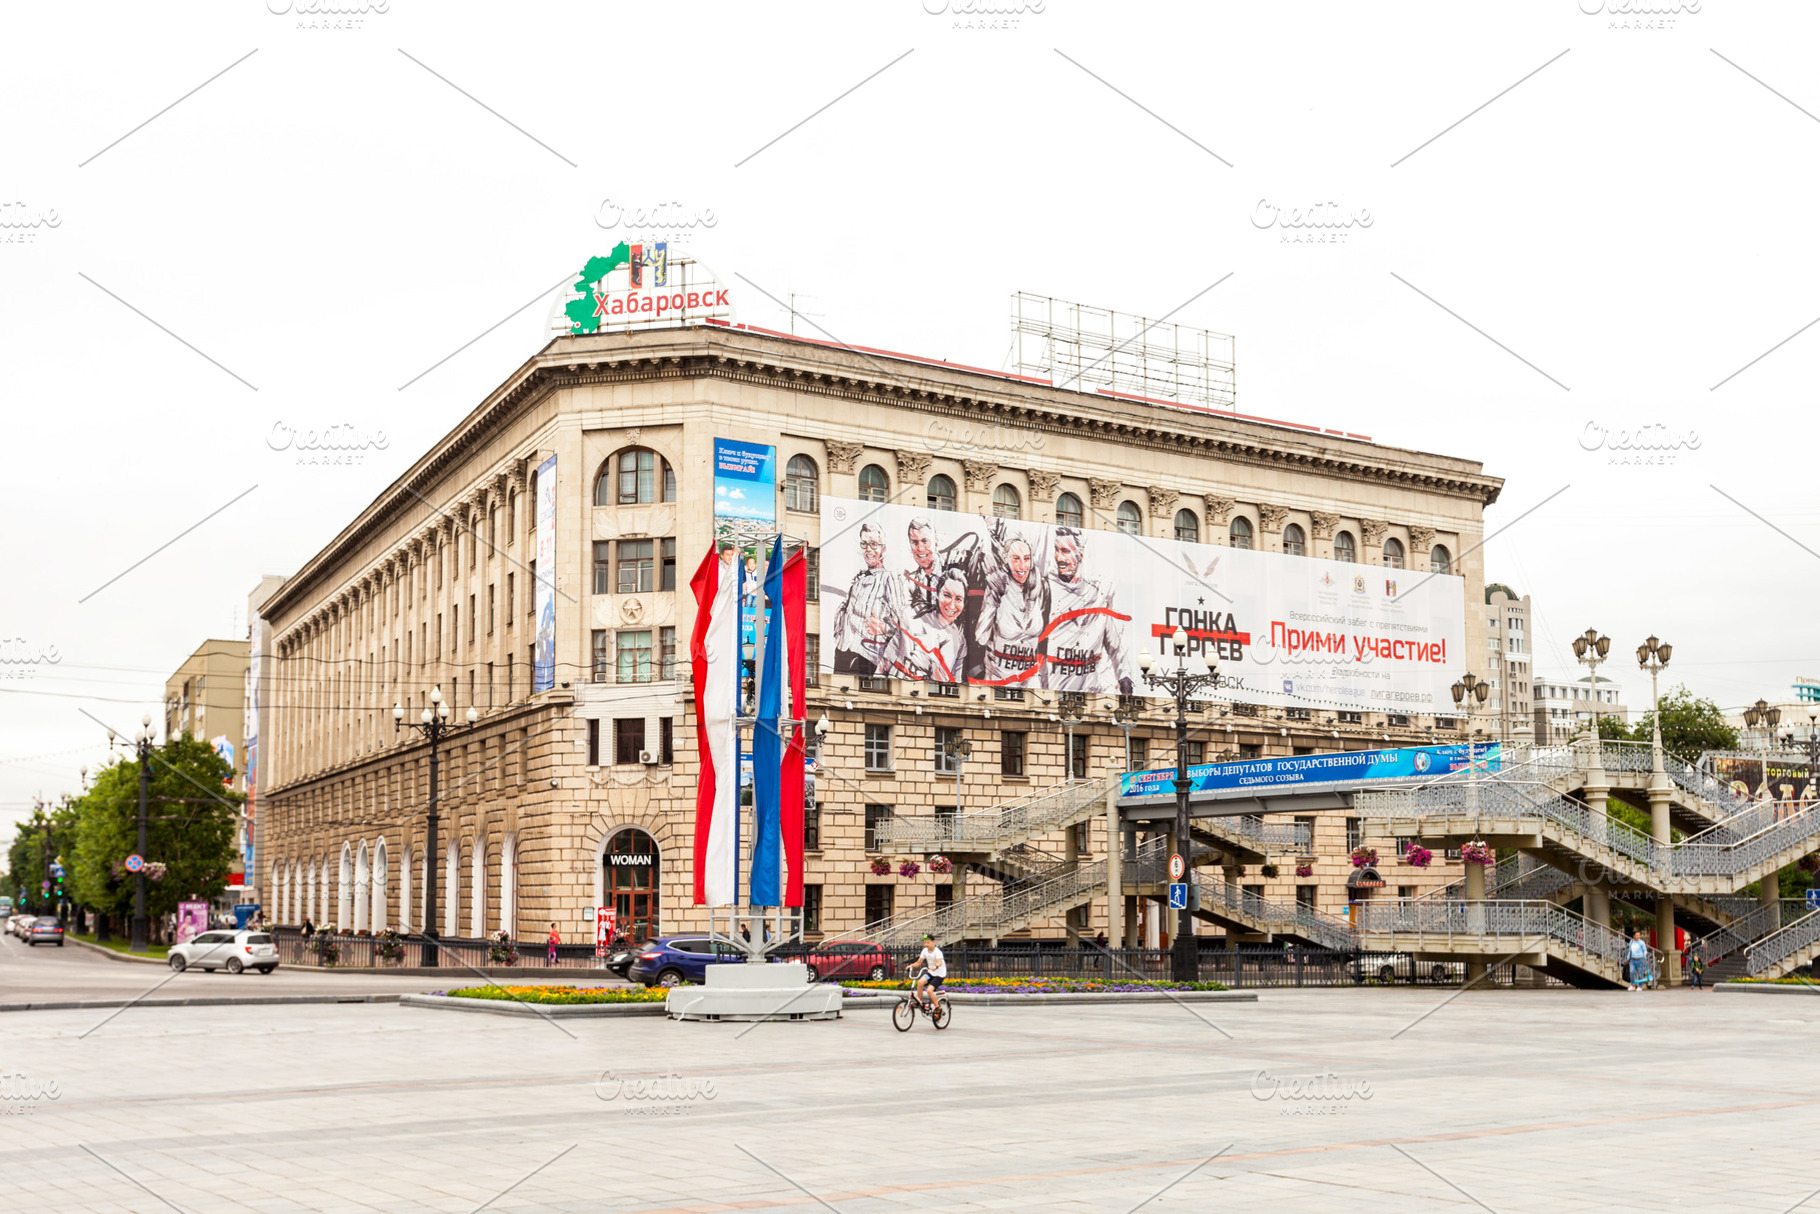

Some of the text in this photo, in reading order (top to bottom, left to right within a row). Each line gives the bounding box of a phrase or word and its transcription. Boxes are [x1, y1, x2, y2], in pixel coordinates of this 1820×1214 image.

[592, 289, 729, 317] Хабаровск
[1165, 607, 1238, 636] ГОНКА
[1289, 611, 1347, 626] Всероссийский
[1348, 617, 1367, 628] забег
[1376, 621, 1429, 633] препятствиями
[1271, 621, 1447, 664] Прими участие!
[1003, 644, 1035, 661] ГОНКА
[1057, 647, 1095, 662] ГОНКА
[1052, 661, 1096, 676] ГЕРОЕВ
[1381, 672, 1391, 680] на
[1186, 753, 1399, 779] ВЫБОРЫ ДЕПУТАТОВ ГОСУДАРСТВЕННОЙ ДУМЫ
[1766, 768, 1810, 779] торговый
[1137, 771, 1174, 783] СЕНТЯБРЯ
[1239, 773, 1305, 785] СЕДЬМОГО СОЗЫВА
[1129, 784, 1160, 793] 2016 года
[610, 855, 652, 865] WOMAN
